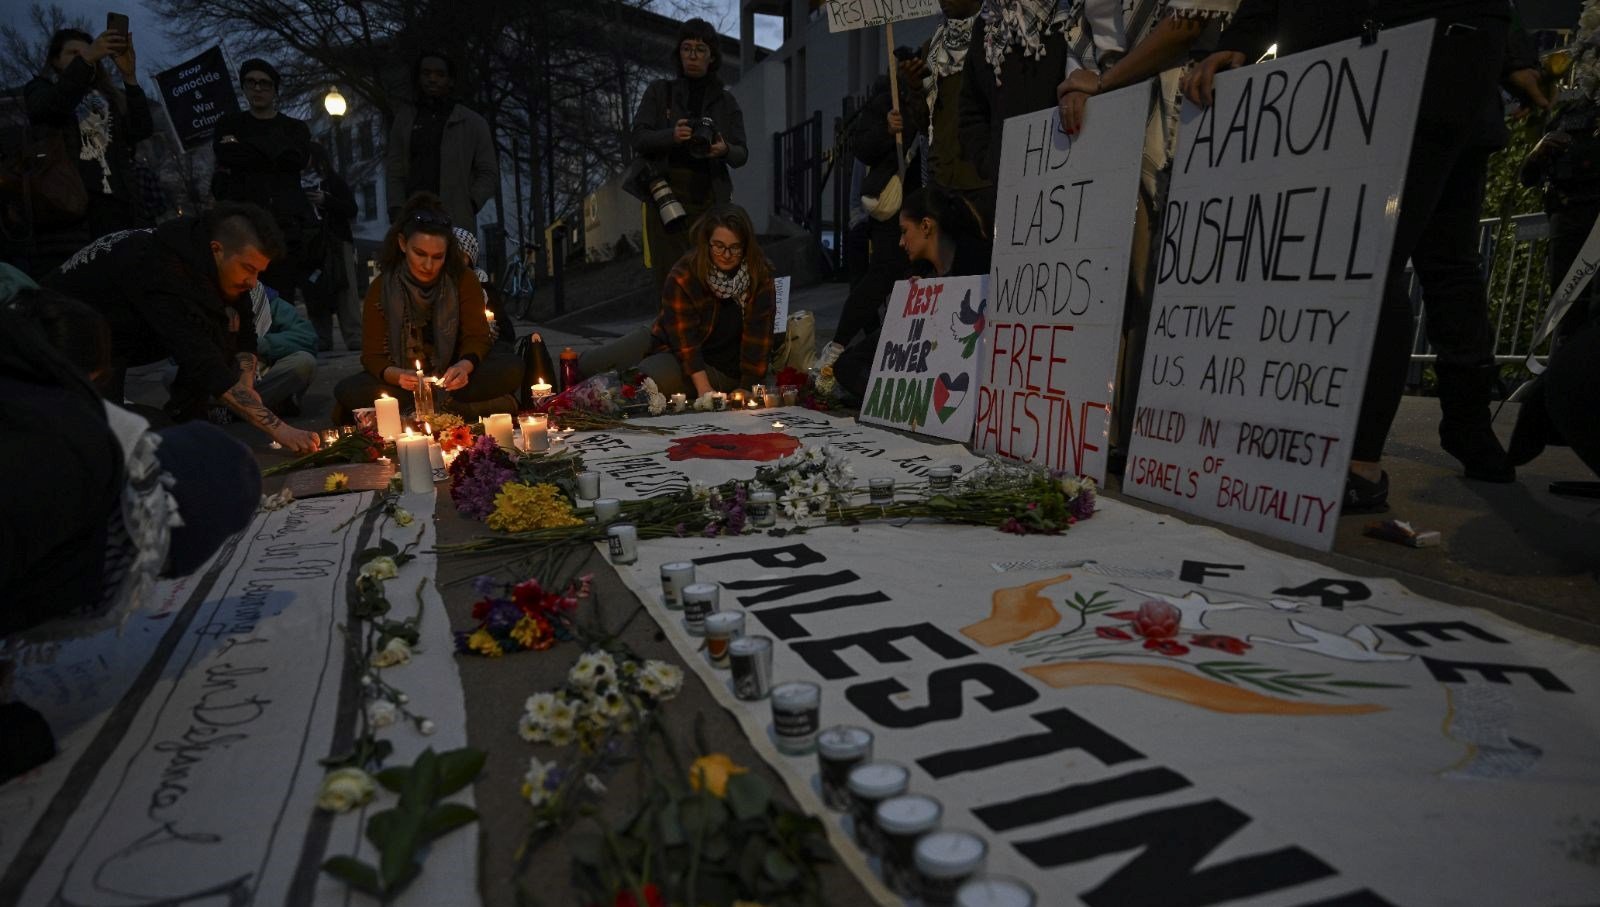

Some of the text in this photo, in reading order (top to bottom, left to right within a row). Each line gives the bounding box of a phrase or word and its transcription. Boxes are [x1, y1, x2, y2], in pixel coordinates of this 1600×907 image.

[172, 71, 221, 97] Genocide
[193, 101, 216, 113] War
[194, 90, 202, 100] &
[1184, 50, 1388, 174] AARON
[1023, 119, 1072, 177] HIS
[1011, 180, 1094, 246] LAST
[1158, 184, 1374, 285] BUSHNELL
[903, 283, 944, 318] REST
[1155, 306, 1350, 345] ACTIVE DUTY
[880, 340, 932, 373] POWER
[908, 318, 925, 342] IN
[864, 377, 936, 428] AARON
[1200, 355, 1245, 397] AIR
[1260, 361, 1347, 408] FORCE
[975, 386, 1107, 484] PALESTINE
[1135, 407, 1339, 468] KILLED IN PROTEST
[1203, 456, 1224, 474] OF
[1130, 456, 1335, 533] ISRAEL'S BRUTALITY
[1179, 560, 1575, 694] FREE
[692, 543, 1399, 907] PALESTIN
